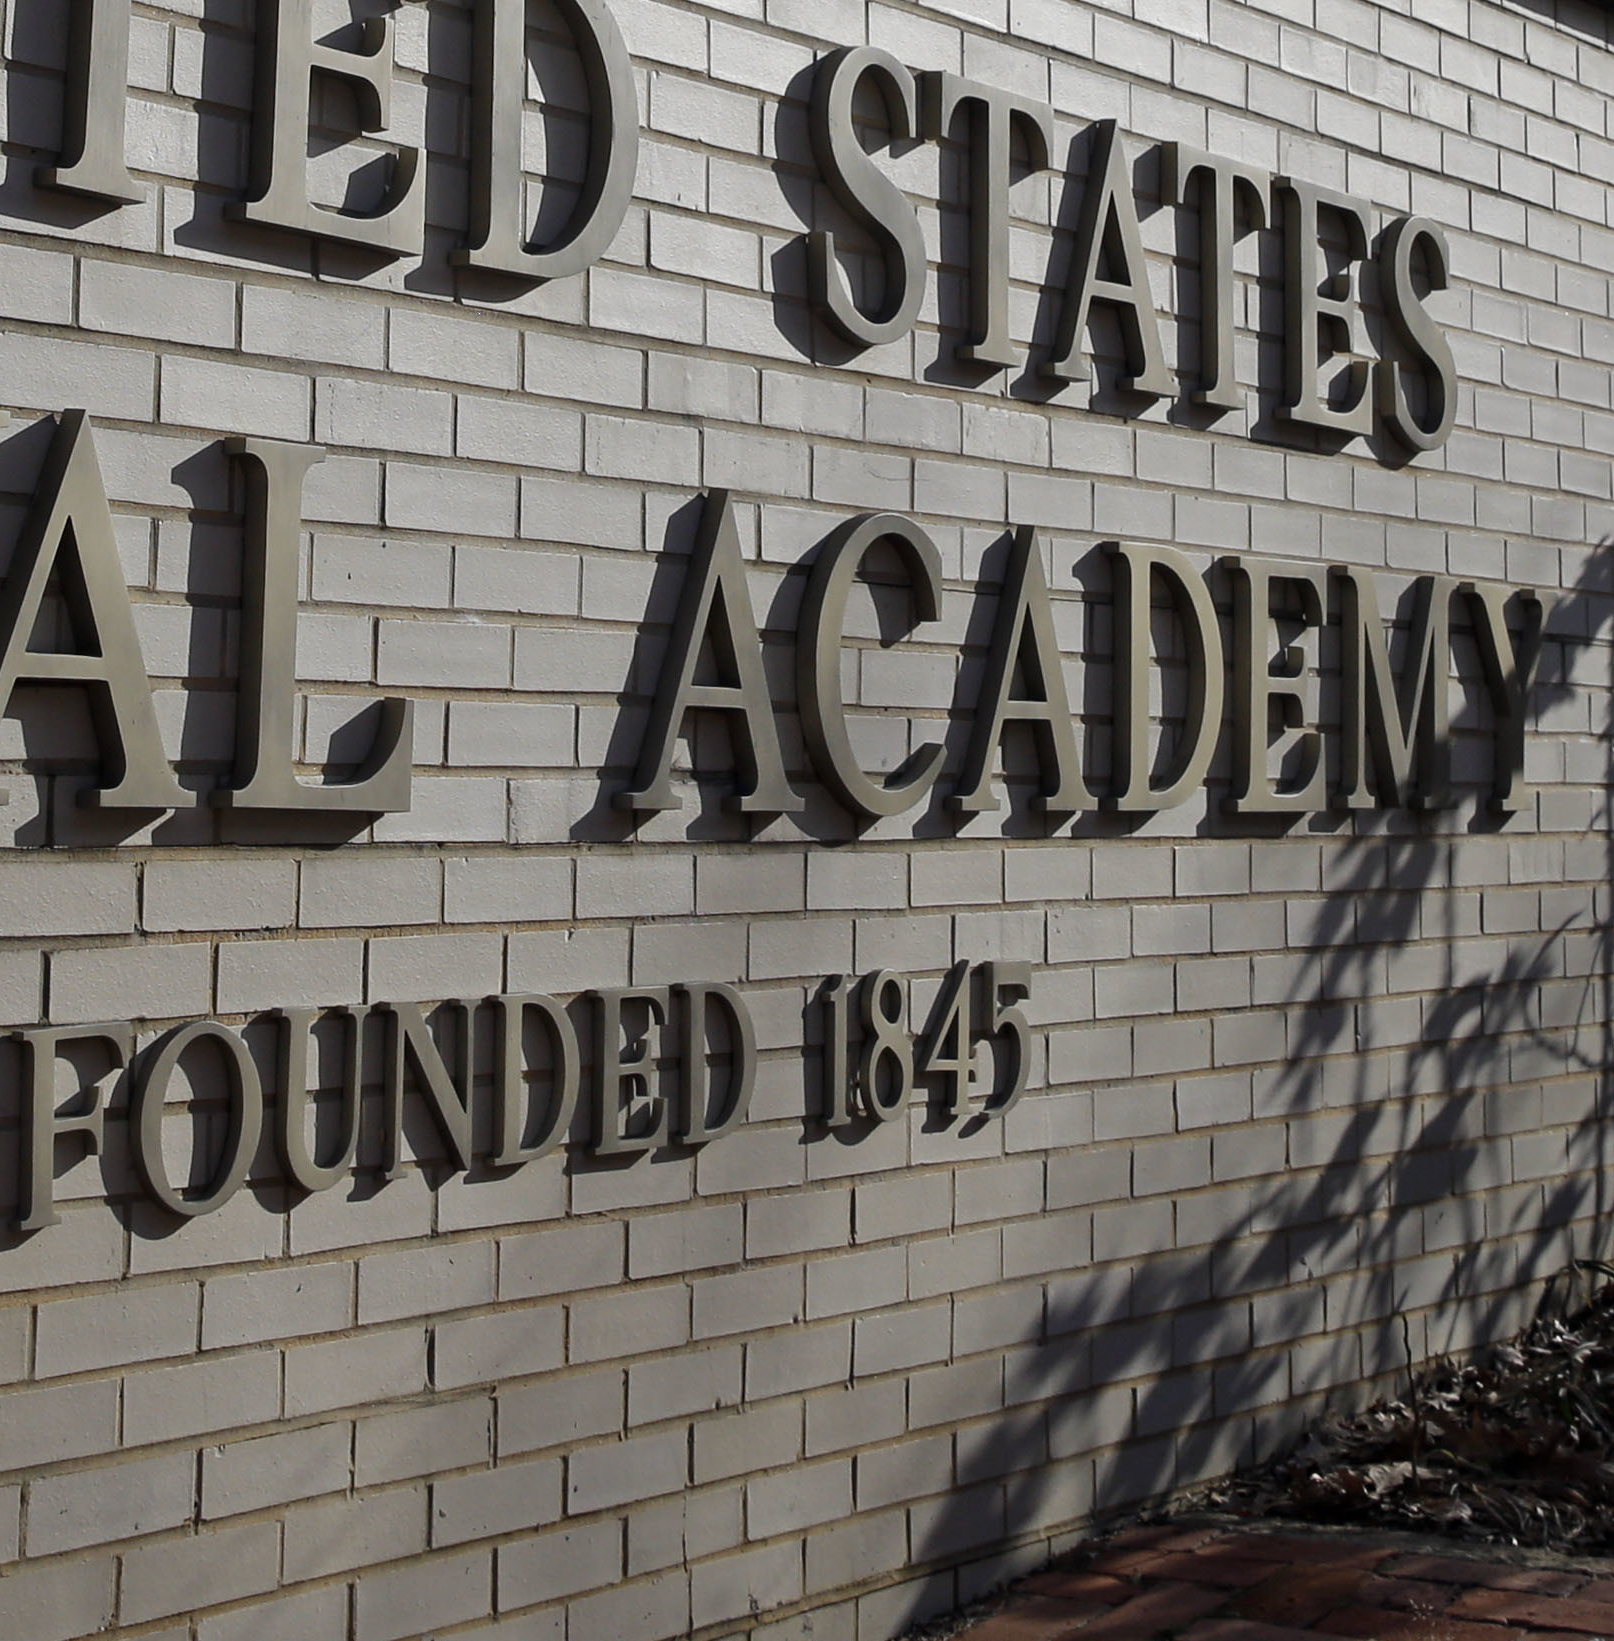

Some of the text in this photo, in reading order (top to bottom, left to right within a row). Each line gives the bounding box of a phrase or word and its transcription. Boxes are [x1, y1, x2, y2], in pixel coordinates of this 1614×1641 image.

[807, 46, 1458, 452] STATES
[614, 488, 1558, 817] ACADEMY
[15, 959, 1032, 1232] FOUNDED 1845
